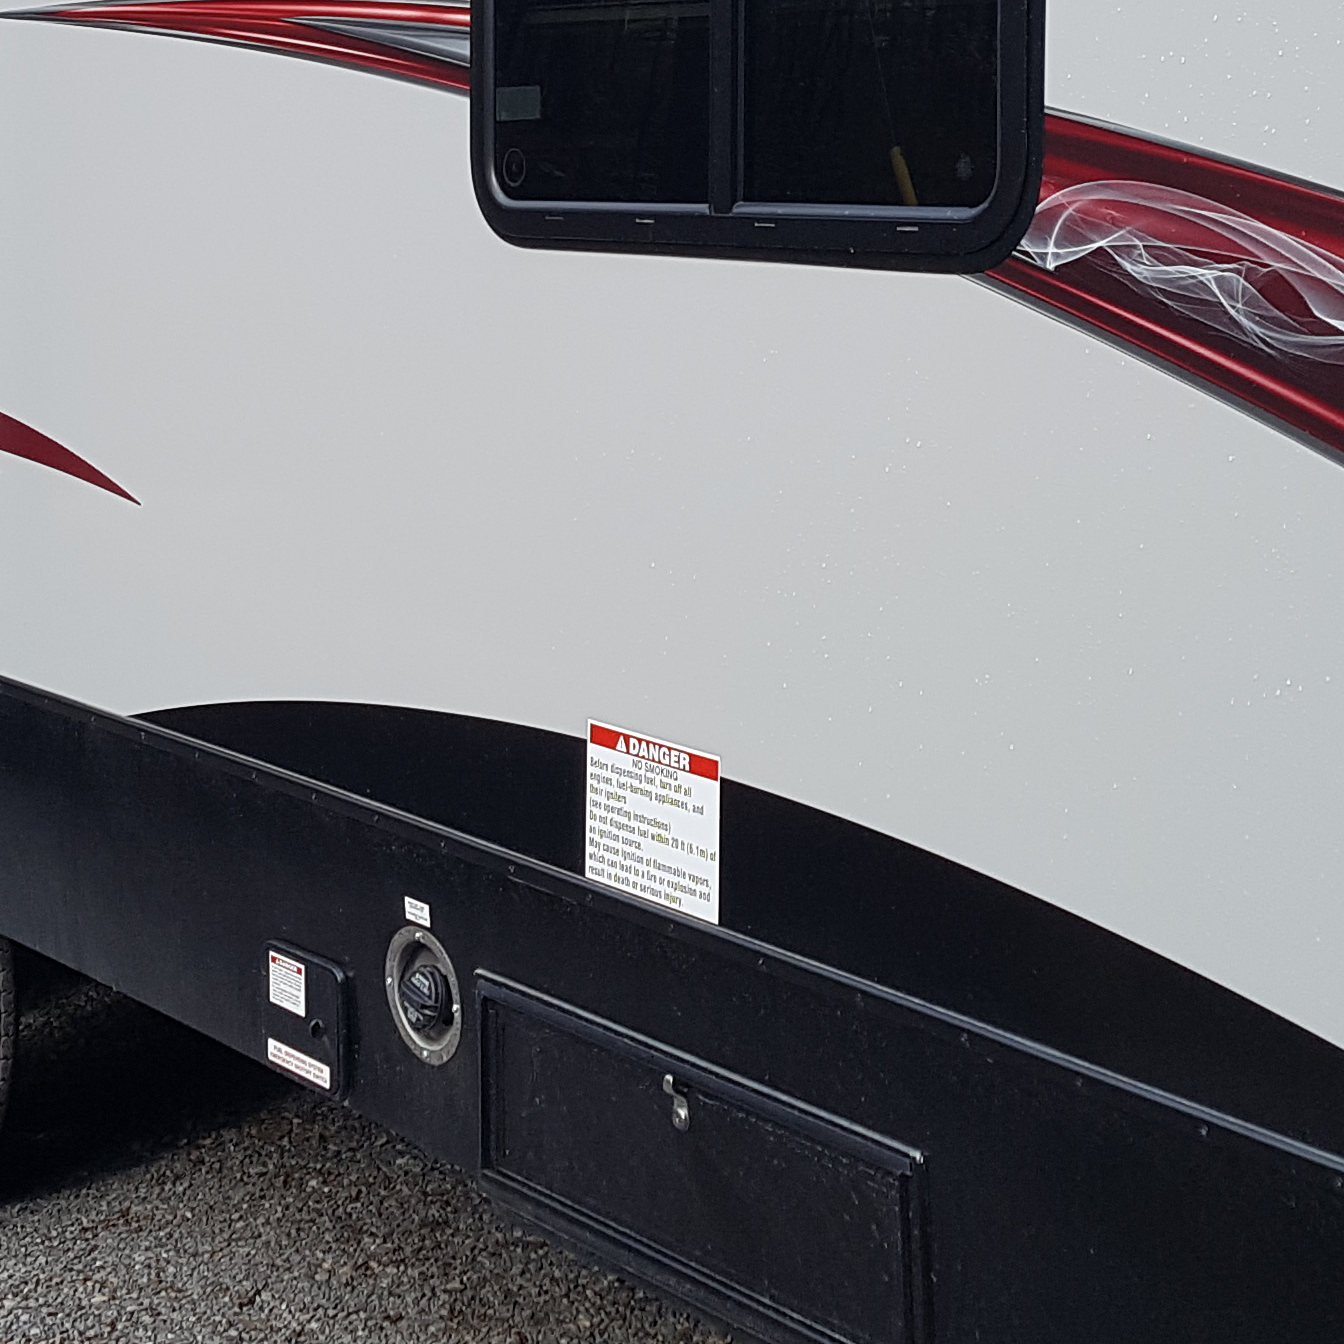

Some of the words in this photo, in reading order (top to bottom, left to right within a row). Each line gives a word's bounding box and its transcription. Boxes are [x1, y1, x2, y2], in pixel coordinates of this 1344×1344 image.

[629, 737, 690, 771] DANGER
[632, 759, 643, 770] NO
[644, 762, 678, 781] SMOKING
[589, 783, 604, 797] their
[605, 787, 627, 804] igniters
[590, 756, 609, 771] Before
[610, 763, 643, 784] dispensing
[673, 784, 683, 794] off
[683, 786, 692, 798] all
[589, 796, 603, 810] (see
[603, 802, 632, 822] operating
[633, 810, 672, 835] instructions)
[692, 804, 704, 816] and
[589, 824, 597, 835] an
[597, 828, 620, 844] ignition
[589, 809, 598, 822] Do
[598, 813, 608, 825] not
[609, 816, 636, 834] dispense
[637, 825, 649, 839] fuel
[650, 832, 670, 846] within
[680, 839, 686, 852] ft
[709, 851, 717, 862] of
[588, 836, 601, 852] May
[602, 843, 620, 857] cause
[621, 847, 644, 864] ignition
[645, 857, 652, 867] of
[653, 858, 687, 879] flammable
[588, 851, 606, 865] which
[607, 857, 618, 868] can
[619, 860, 632, 875] lead
[633, 866, 640, 877] to
[646, 870, 657, 884] fire
[658, 876, 666, 887] or
[666, 879, 698, 897] explosion
[698, 890, 711, 903] and
[588, 864, 605, 879] result
[606, 868, 613, 880] in
[613, 872, 631, 888] death
[631, 879, 639, 888] or
[639, 882, 663, 900] serious
